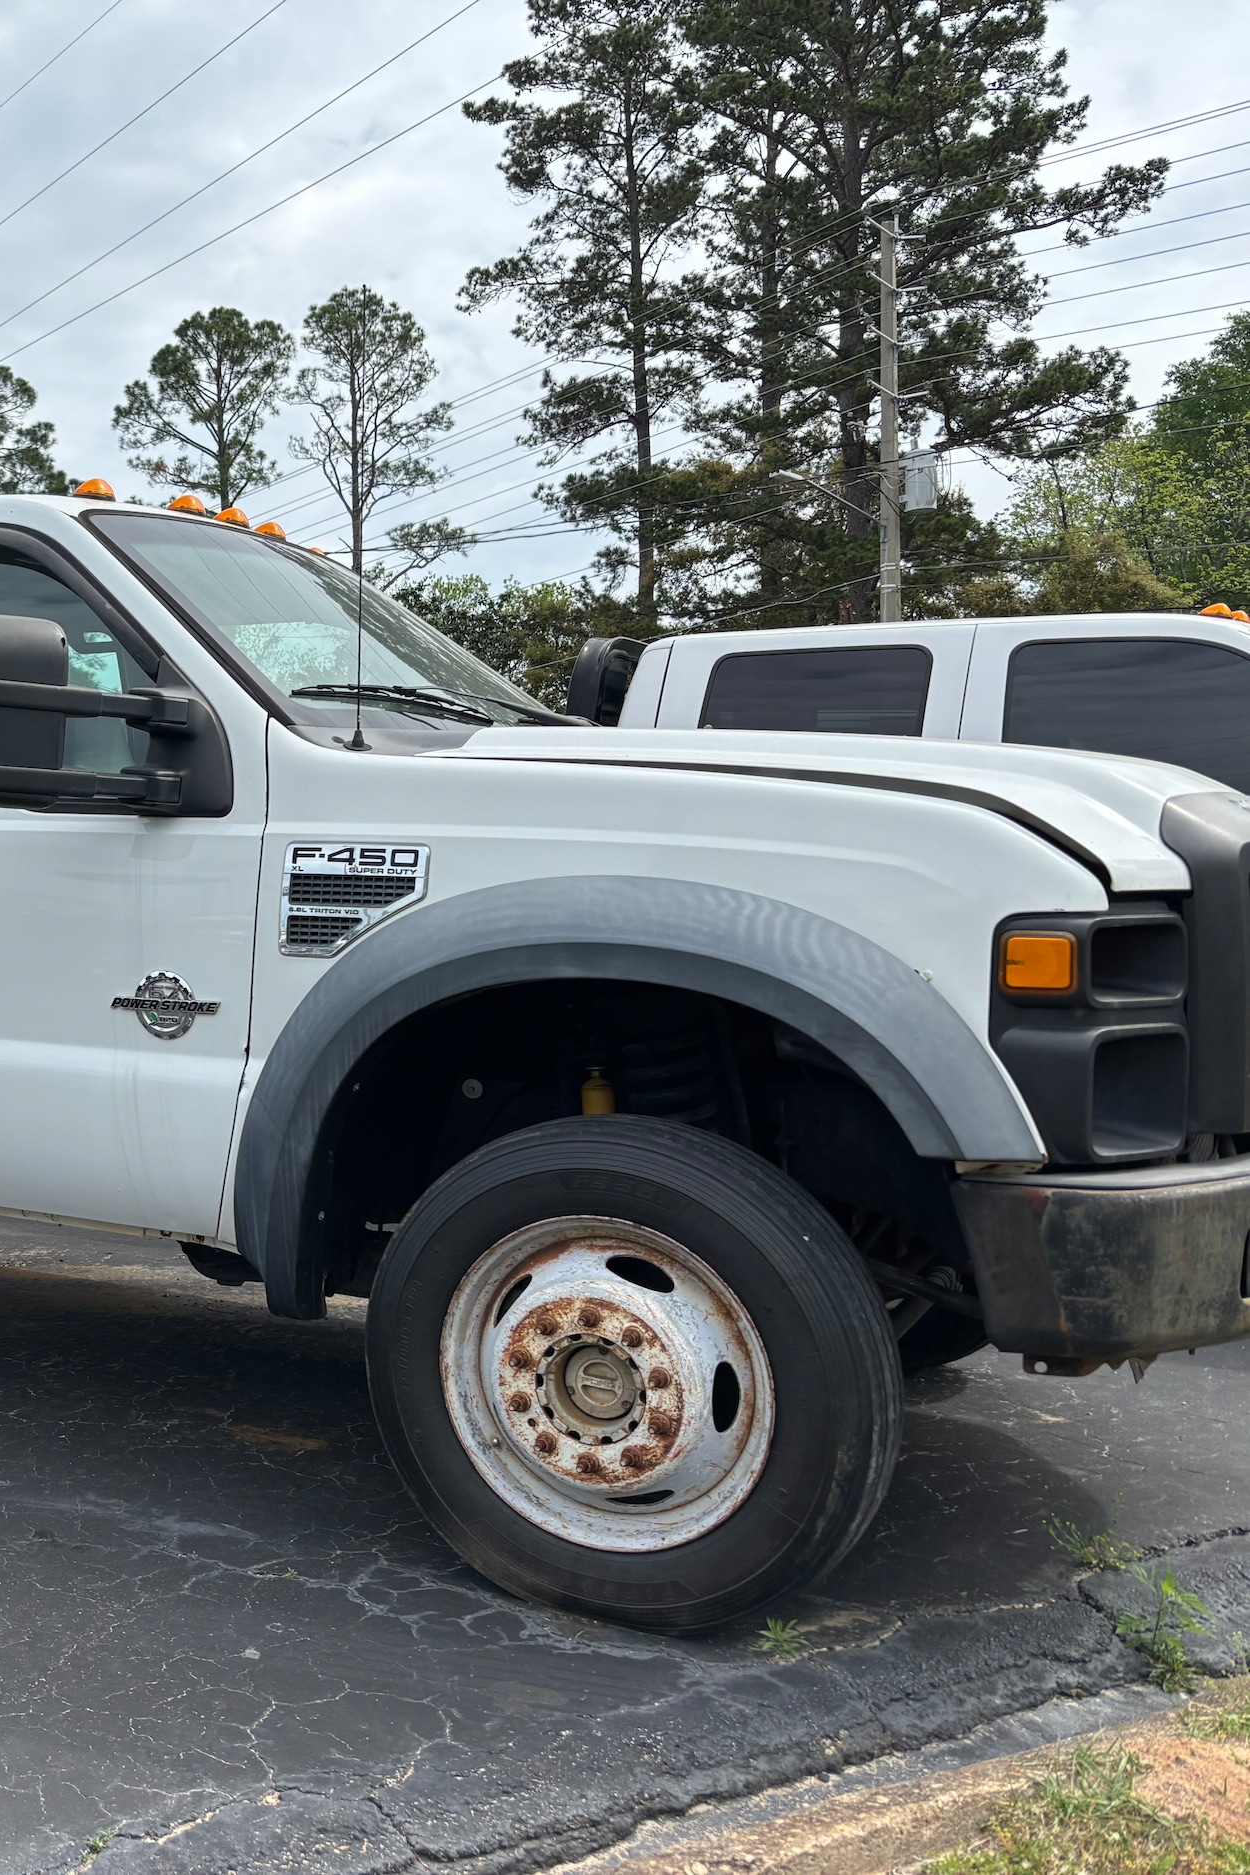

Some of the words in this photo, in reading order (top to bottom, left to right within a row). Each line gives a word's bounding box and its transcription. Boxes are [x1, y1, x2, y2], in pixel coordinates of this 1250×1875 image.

[291, 847, 419, 867] F-450
[348, 867, 384, 875] SUPER
[386, 868, 418, 876] DUTY
[111, 997, 159, 1010] POWER
[160, 1000, 218, 1013] STROKE
